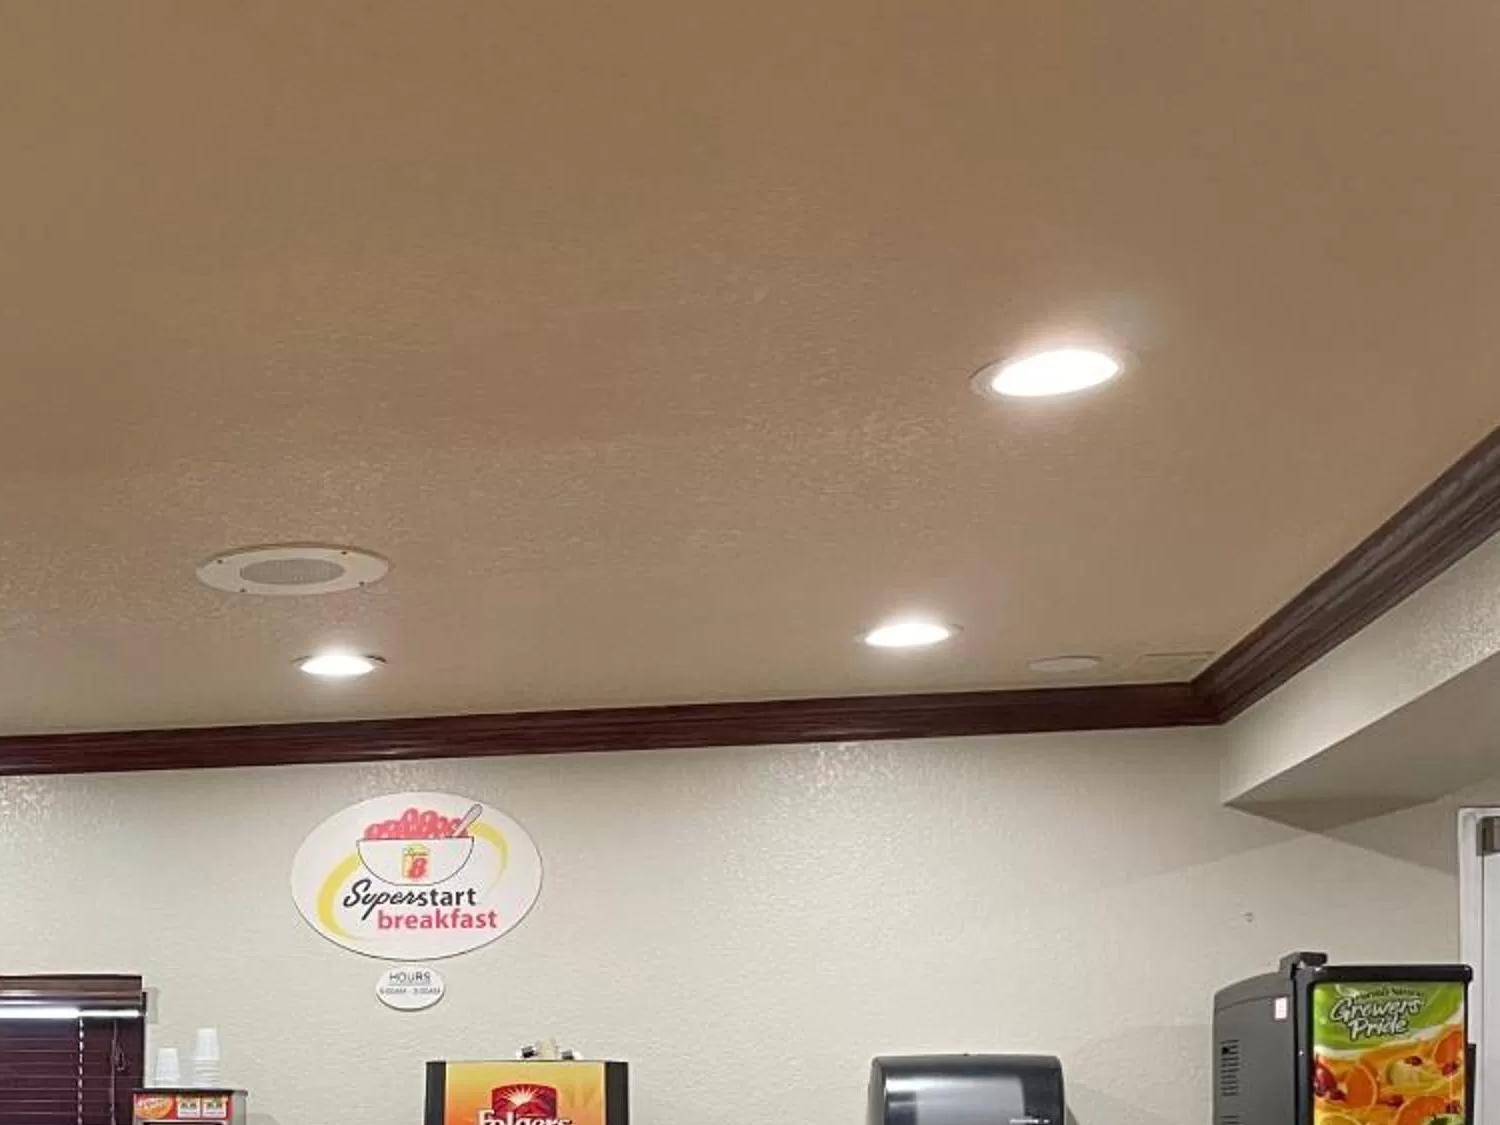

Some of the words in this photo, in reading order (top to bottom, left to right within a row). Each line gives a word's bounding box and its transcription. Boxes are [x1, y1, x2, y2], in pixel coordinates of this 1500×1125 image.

[408, 857, 427, 878] 8
[343, 879, 477, 921] Superstart
[378, 909, 498, 929] breakfast
[389, 971, 431, 982] HOURS
[1329, 996, 1422, 1022] Growers
[1348, 1015, 1409, 1041] Pride
